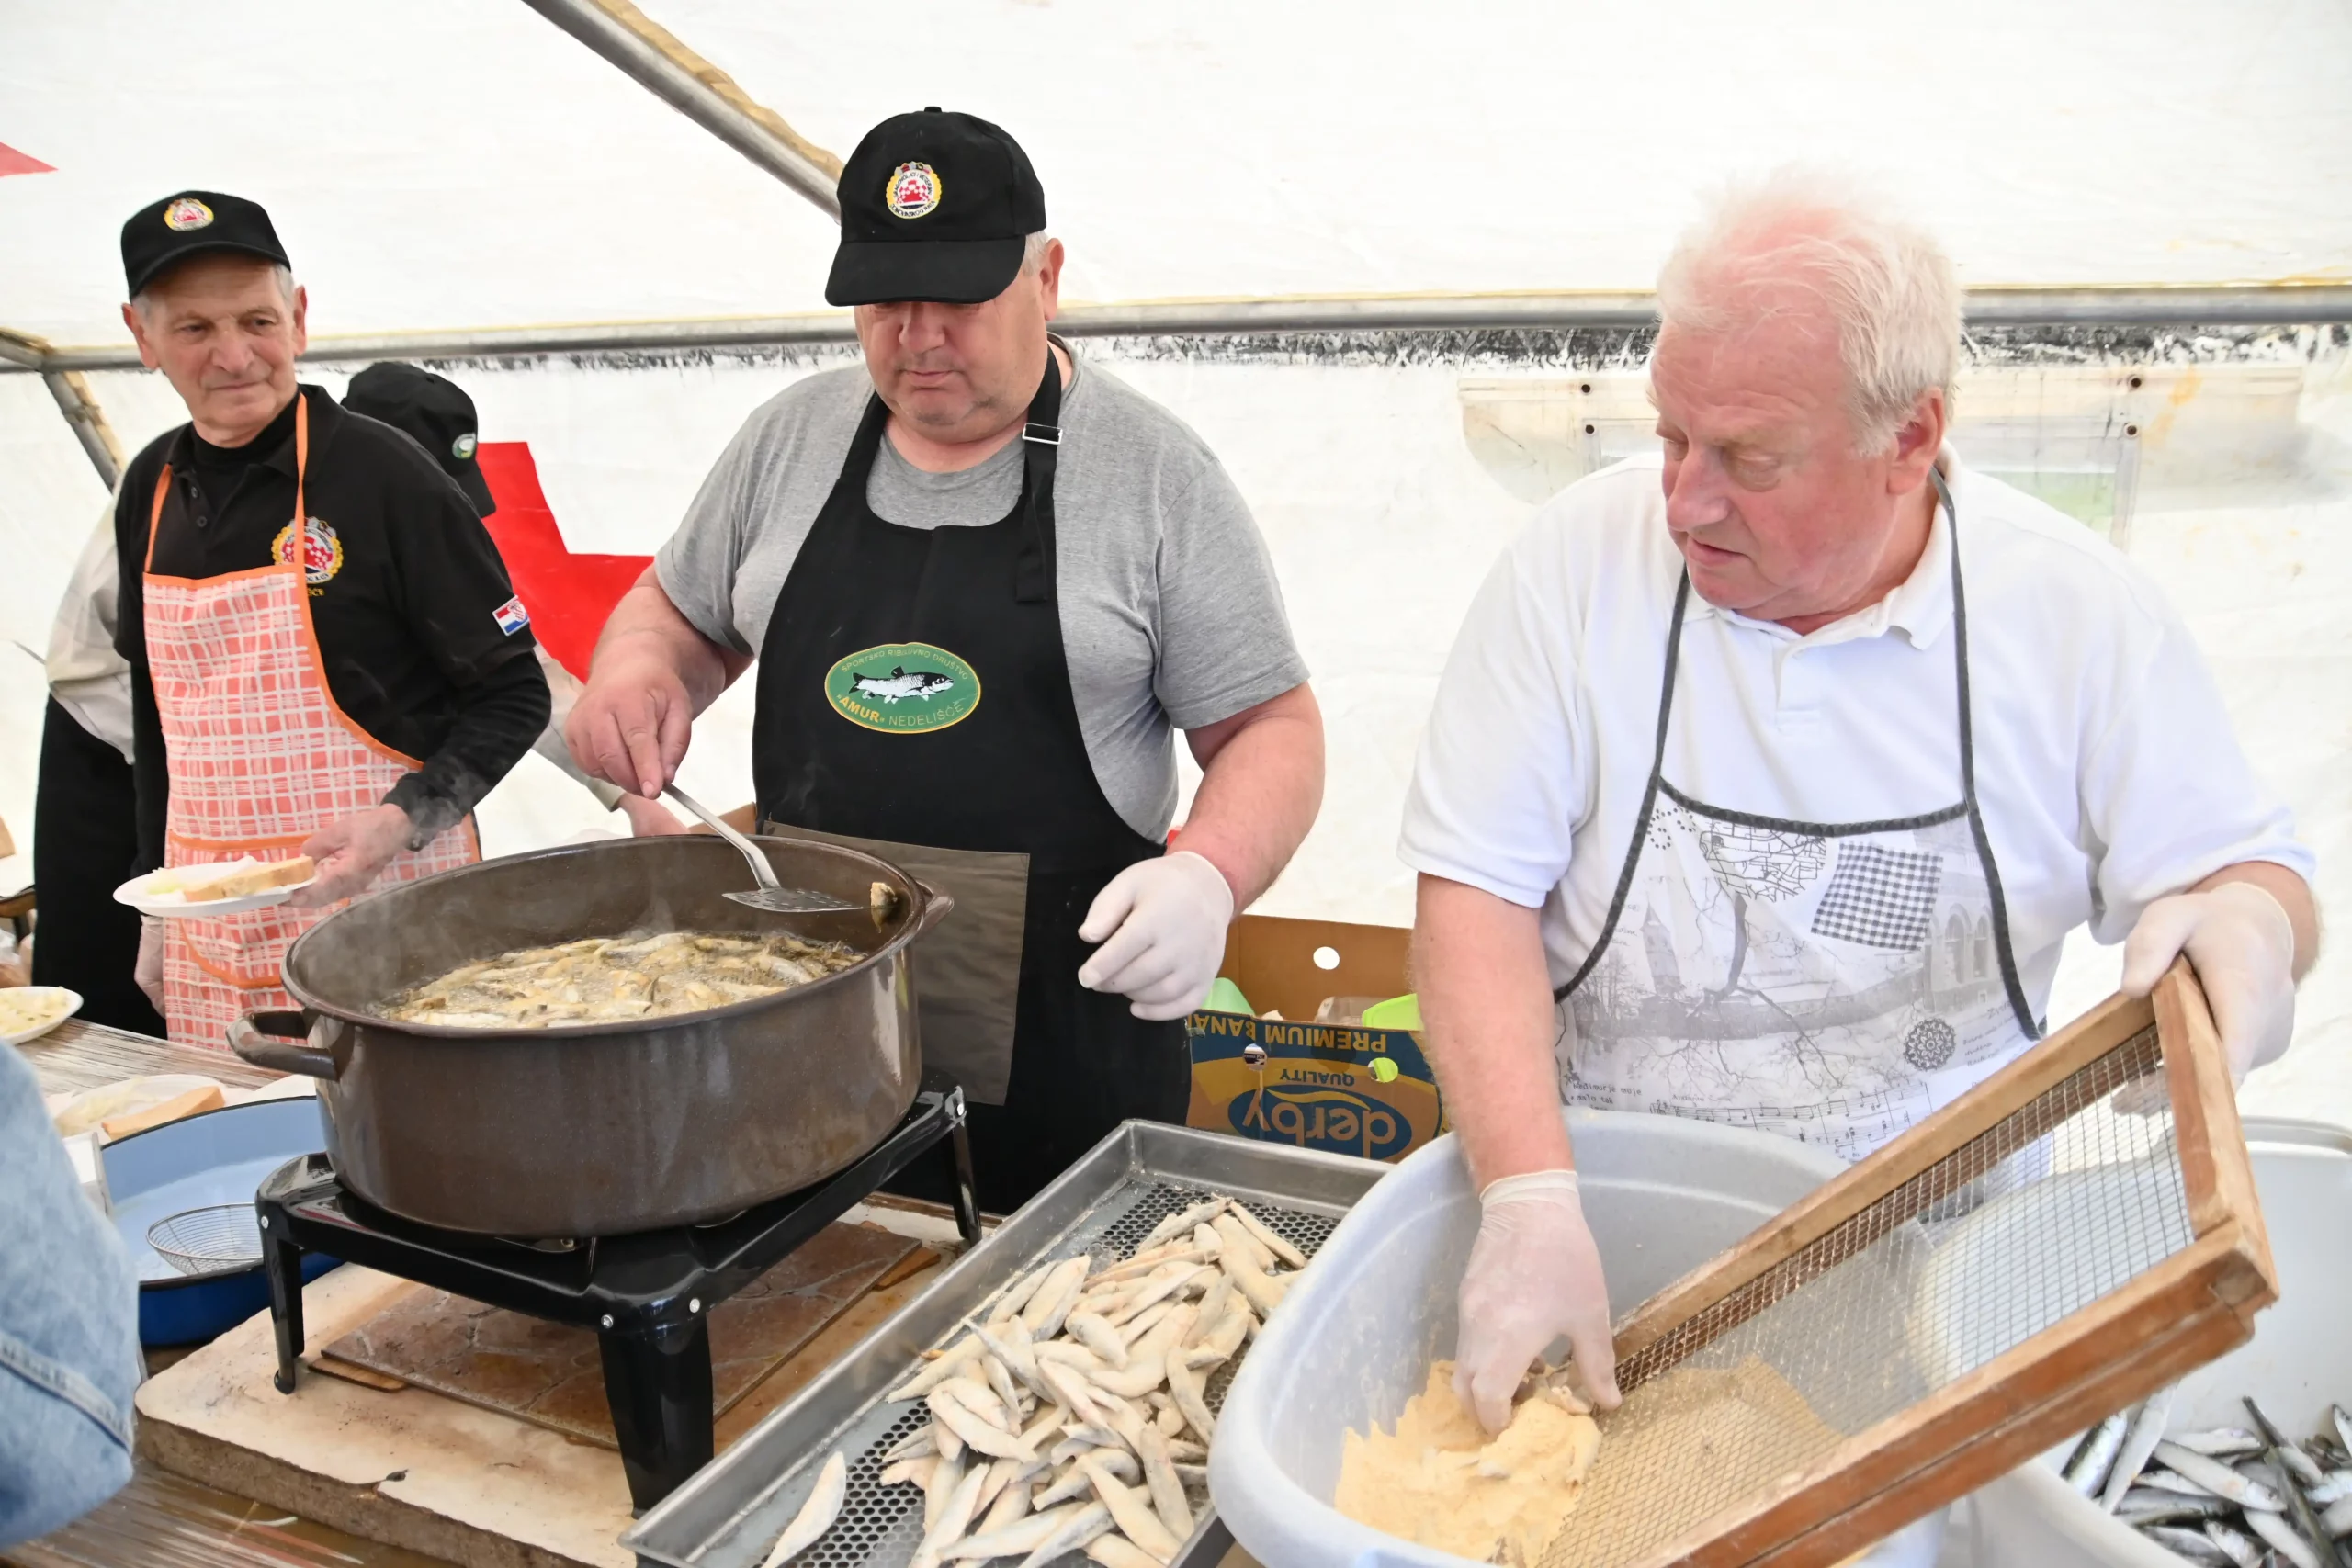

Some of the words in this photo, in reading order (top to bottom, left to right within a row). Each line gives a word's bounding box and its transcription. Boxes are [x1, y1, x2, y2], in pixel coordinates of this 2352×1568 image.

[841, 650, 885, 672] SPORTSKO
[932, 653, 968, 680] DRUŠTVO
[1265, 1024, 1386, 1053] PREMIUM
[1279, 1068, 1355, 1087] QUALITY
[1242, 1088, 1396, 1159] derby
